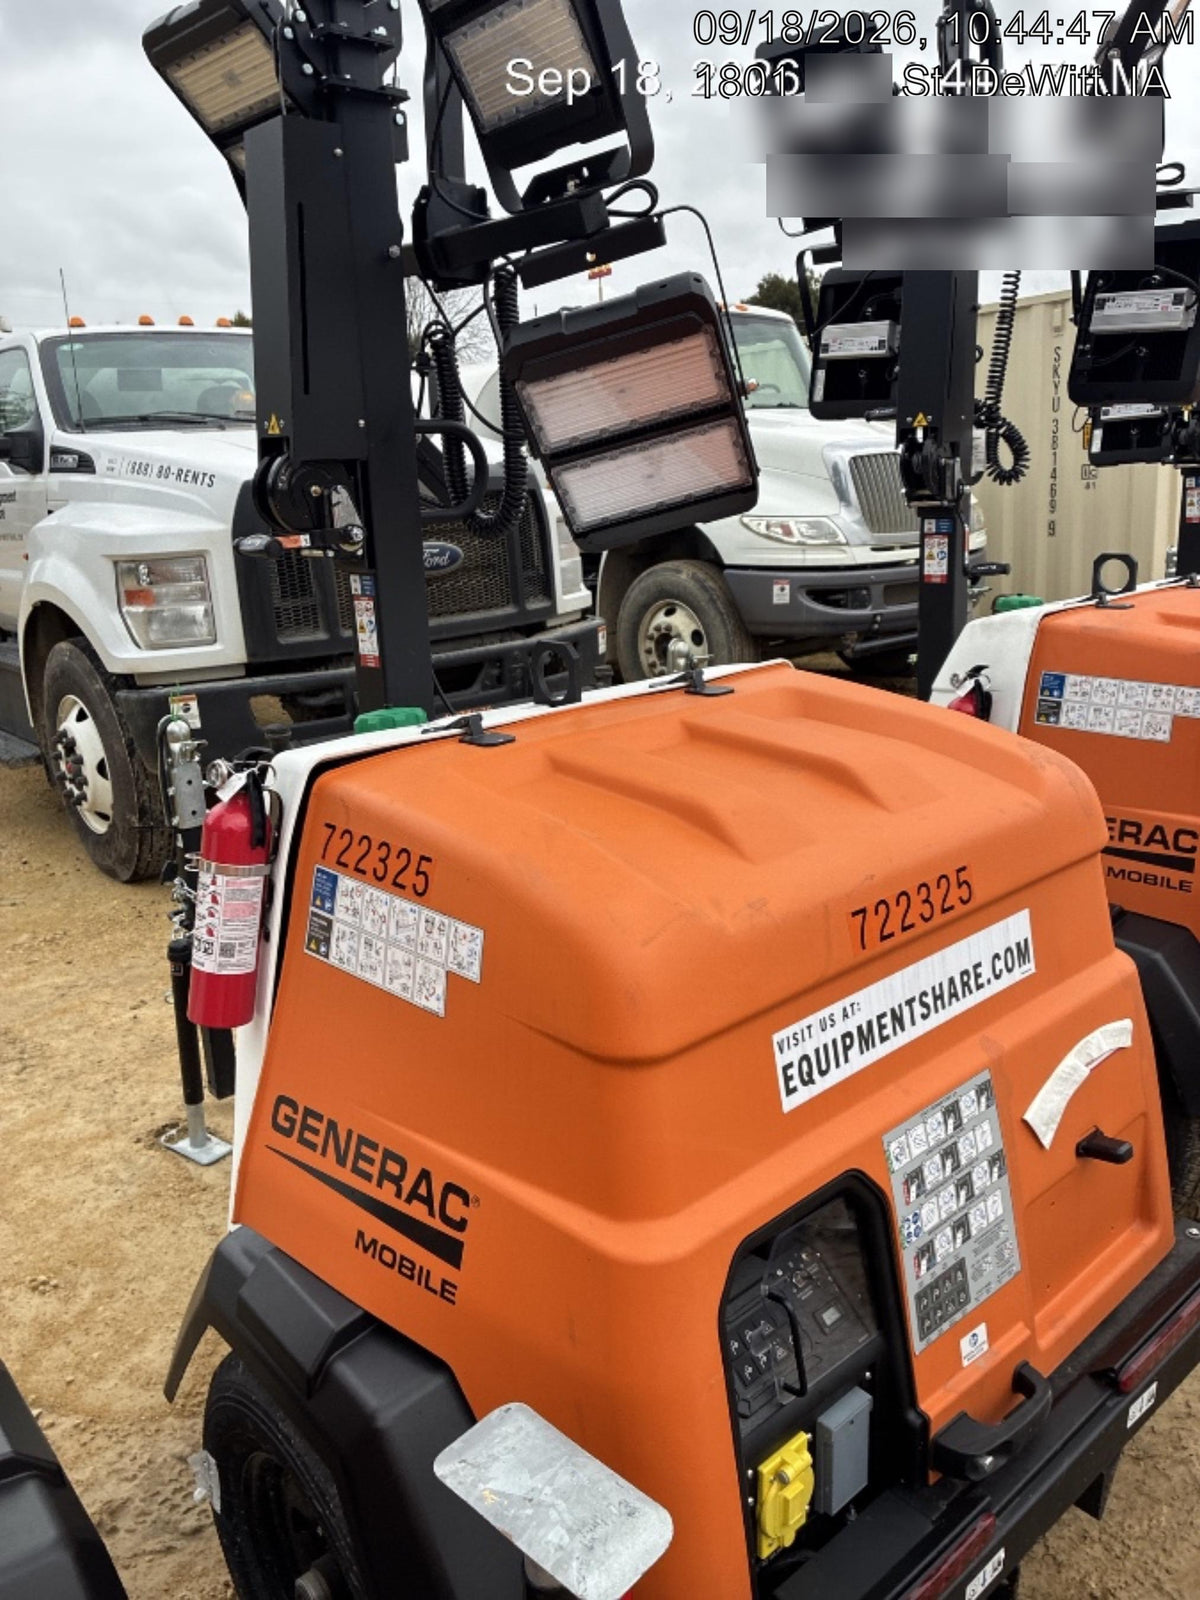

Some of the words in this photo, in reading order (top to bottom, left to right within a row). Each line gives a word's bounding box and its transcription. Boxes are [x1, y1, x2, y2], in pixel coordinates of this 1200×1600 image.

[1052, 346, 1061, 413] SKYU
[321, 822, 433, 897] 722325
[1106, 866, 1194, 893] MOBILE
[850, 865, 972, 950] 722325
[776, 1024, 814, 1055] VISIT
[819, 1012, 836, 1032] US
[841, 1000, 861, 1022] AT:
[781, 937, 1031, 1098] EQUIPMENTSHARE.COM
[354, 1229, 458, 1306] MOBILE
